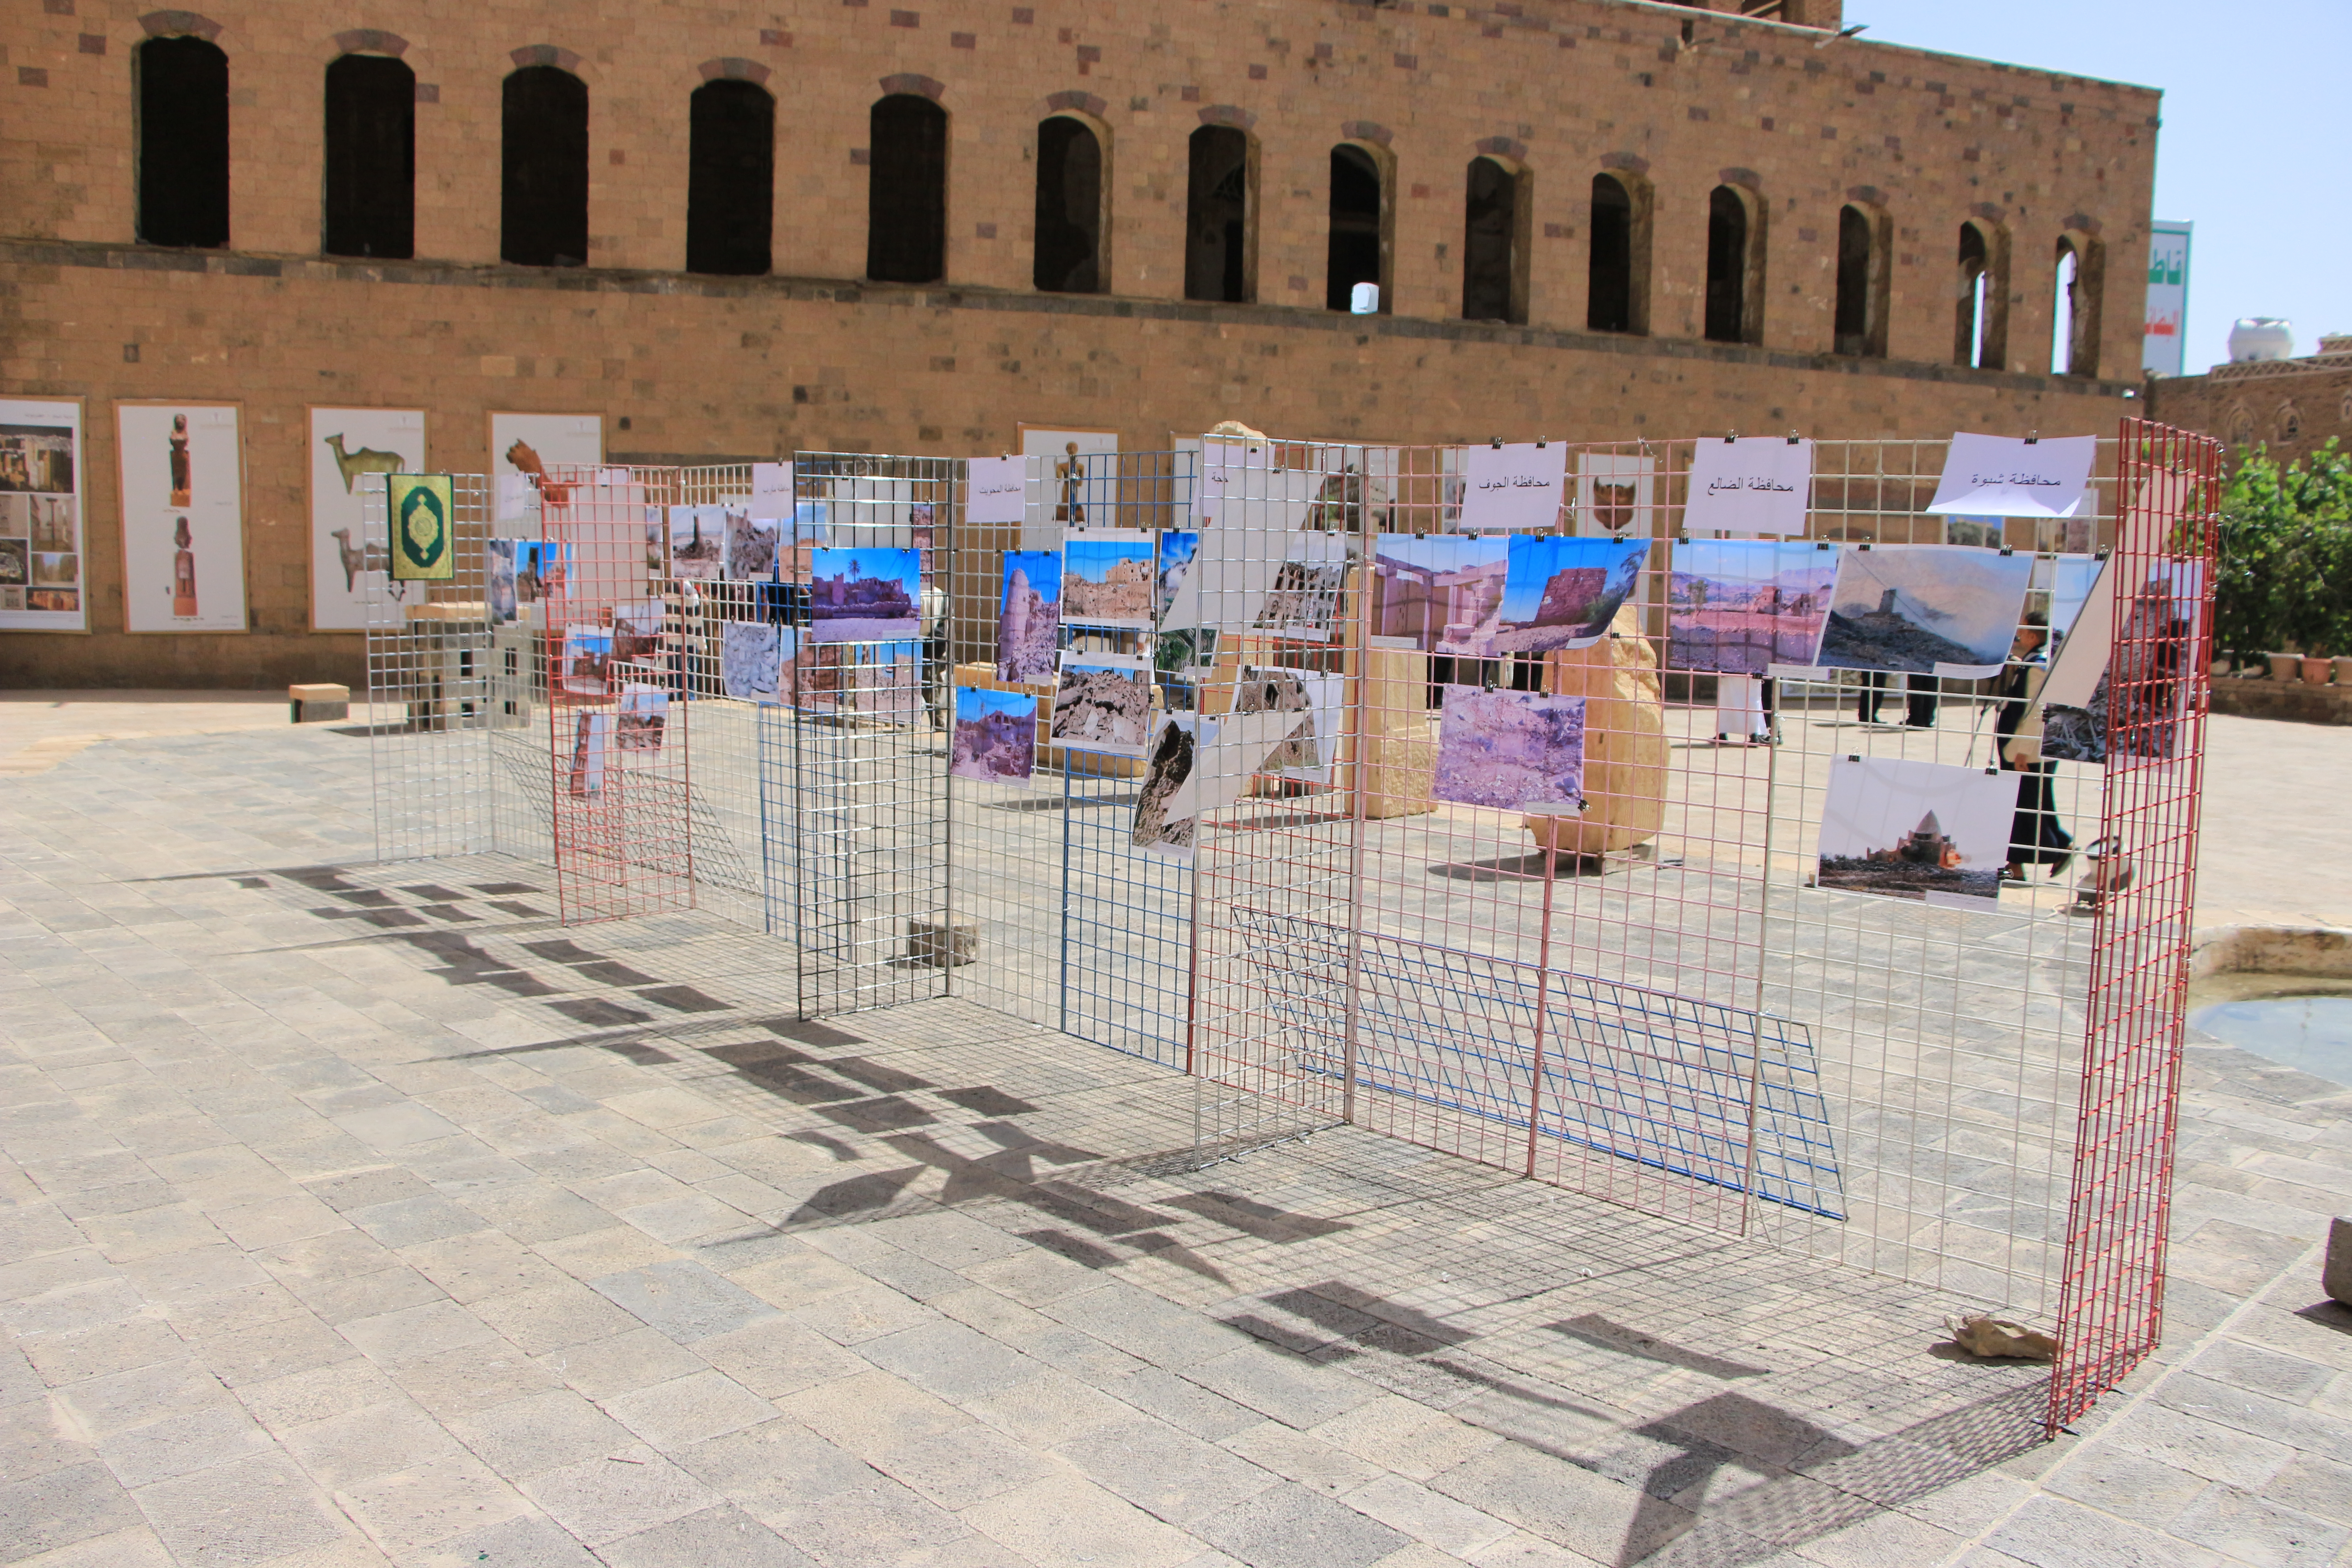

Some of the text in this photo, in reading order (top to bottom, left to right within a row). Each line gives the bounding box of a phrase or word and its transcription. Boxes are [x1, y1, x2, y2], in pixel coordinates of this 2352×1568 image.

[2149, 248, 2182, 285] قاط
[1479, 475, 1550, 492] محافظة الجوف
[1707, 477, 1794, 495] محافظة الضالع
[1971, 473, 2061, 487] محافظة شبوة
[979, 483, 1021, 496] محافظة المحويت
